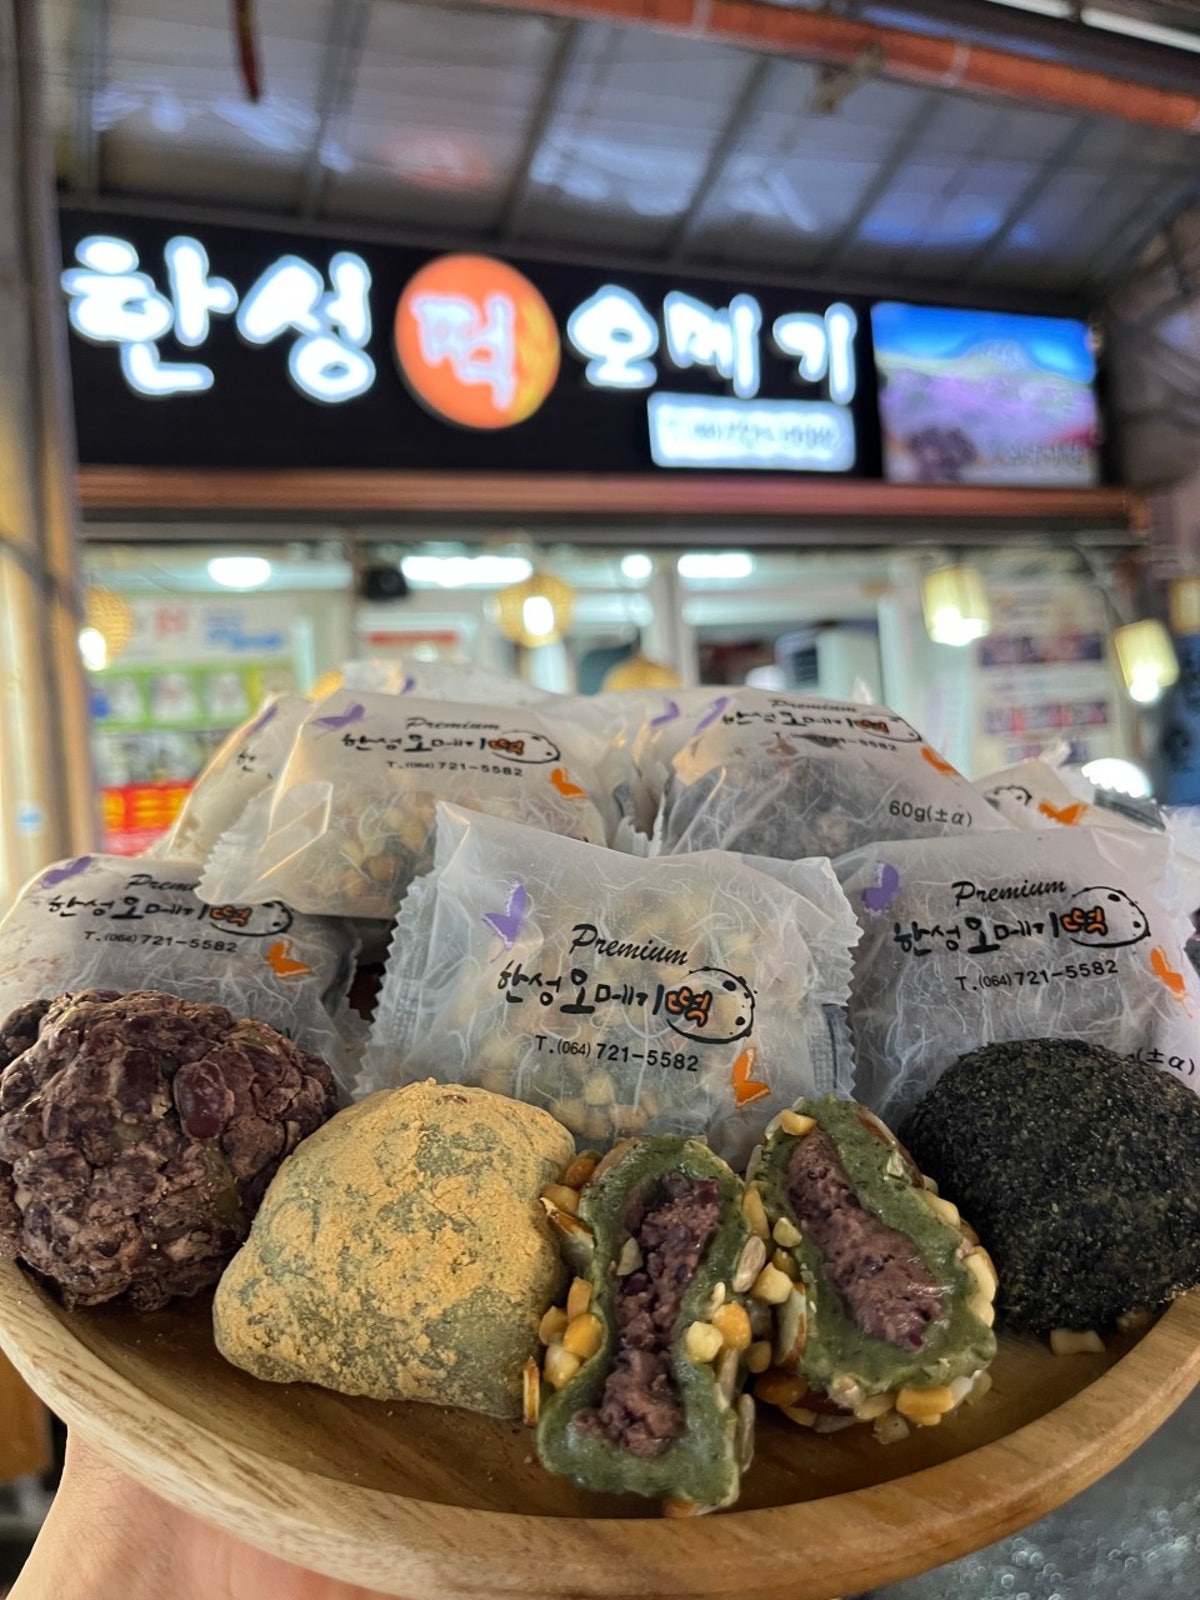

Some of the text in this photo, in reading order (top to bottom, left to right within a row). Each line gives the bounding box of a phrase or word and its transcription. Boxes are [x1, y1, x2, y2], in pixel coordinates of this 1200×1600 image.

[61, 235, 857, 411] 한성 떡 오메기
[405, 717, 501, 731] Premium
[952, 879, 1067, 907] Premium
[569, 923, 689, 967] Premium
